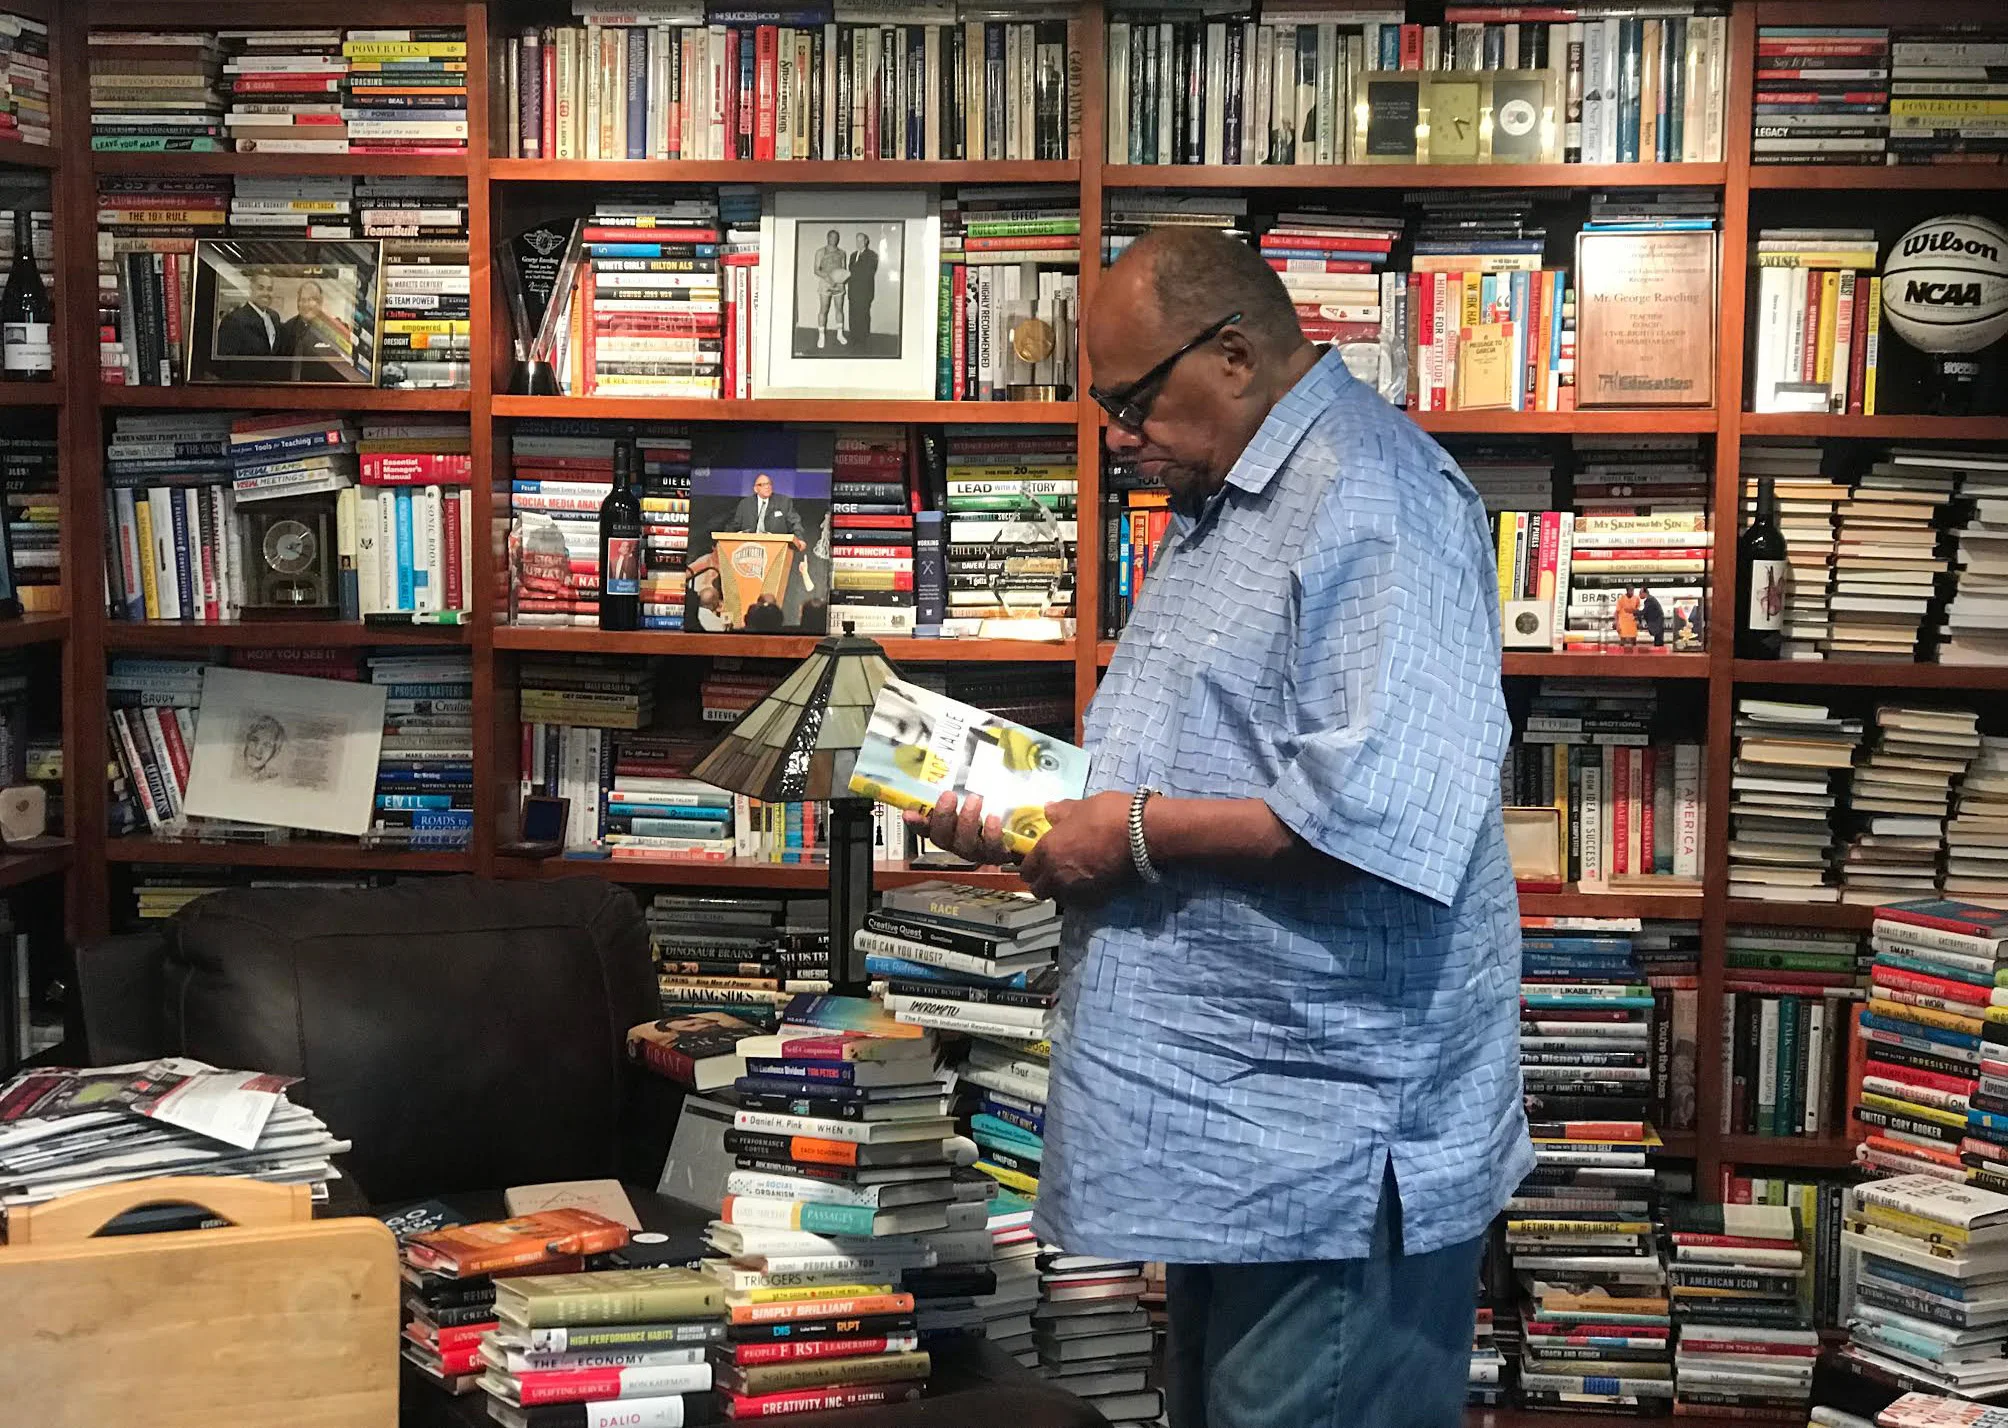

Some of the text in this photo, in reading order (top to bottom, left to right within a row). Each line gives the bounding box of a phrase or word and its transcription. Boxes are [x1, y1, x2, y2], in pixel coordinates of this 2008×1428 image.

[1756, 128, 1788, 137] LEGACY
[96, 140, 118, 150] LEAVE
[140, 140, 160, 148] MARK
[129, 212, 187, 220] THE 10X RULE
[364, 226, 419, 236] TeamBuilt
[972, 224, 1054, 235] RULES RENEGADES
[1903, 231, 1998, 262] Wilson
[598, 260, 693, 270] WHITE GIRLS HILTON ALS
[1759, 255, 1800, 267] EXCUSES
[1386, 282, 1394, 314] Insanely
[1614, 293, 1650, 305] George
[1654, 293, 1700, 305] Raveling
[1904, 281, 1981, 305] NCAA
[1838, 274, 1854, 343] GOALS! BRIAN TRACY
[942, 275, 950, 358] PLAYING TO WIN
[981, 282, 990, 368] HIGHLY RECOMMENDED
[954, 295, 963, 382] TIPPING SACRED COWS
[1434, 338, 1442, 383] ATTITUDE
[1806, 344, 1814, 380] REVOLUTION
[237, 464, 302, 476] VISUAL TEAMS
[237, 473, 305, 488] VISUAL MEETINGS
[958, 484, 992, 493] LEAD
[1032, 483, 1056, 492] TORY
[517, 497, 602, 508] SOCIAL MEDIA ANALY
[395, 686, 463, 696] PROCESS MATTERS
[928, 712, 964, 784] FACE VALUE
[421, 816, 451, 825] ROADS
[1586, 770, 1595, 867] FROM IDEA TO SUCCESS
[1684, 789, 1695, 855] AMERICA
[930, 903, 959, 915] RACE
[868, 919, 922, 939] Creative Quest
[665, 947, 753, 958] DINOSAUR BRAINS
[860, 937, 943, 961] WHO CAN YOU TRUST?
[1890, 946, 1914, 956] SMART
[875, 961, 889, 972] Hit
[1877, 974, 1944, 994] HACKING GROWTH
[680, 990, 753, 1001] TAKING SIDES
[909, 1002, 960, 1016] IMPROMPTU
[1924, 999, 1945, 1009] WORK
[939, 1019, 969, 1028] Industrial
[971, 1022, 1004, 1033] Revolution
[1539, 1055, 1580, 1064] Disney
[1583, 1055, 1607, 1064] Way
[1658, 1021, 1669, 1099] You're the Boss
[1909, 1056, 1969, 1073] IRRESISTIBLE
[1011, 1063, 1029, 1077] four
[750, 1116, 843, 1135] Daniel H. Pink WHEN
[1861, 1111, 1942, 1136] UNITED CORY BOOKER
[739, 1137, 784, 1147] PERFORMANCE
[766, 1180, 793, 1189] SOCIAL
[755, 1189, 794, 1198] ORGANISM
[807, 1210, 852, 1221] PASSAGES
[1521, 1222, 1619, 1232] RETURN ON INFLUENCE
[803, 1260, 874, 1270] PEOPLE BUY YOU
[744, 1274, 801, 1287] TRIGGERS
[1689, 1277, 1758, 1288] AMERICAN ICON
[752, 1302, 854, 1320] SIMPLY BRILLIANT
[773, 1321, 860, 1336] DIS RUPT
[570, 1331, 673, 1345] HIGH PERFORMANCE HABITS
[744, 1348, 776, 1357] PEOPLE
[825, 1340, 877, 1350] LEADERSHIP
[534, 1355, 644, 1367] THE ECONOMY
[532, 1384, 611, 1397] UPLIFTING SERVICE
[763, 1400, 822, 1414] CREATIVITY,
[825, 1397, 844, 1408] INC.
[600, 1414, 640, 1427] DALIO
